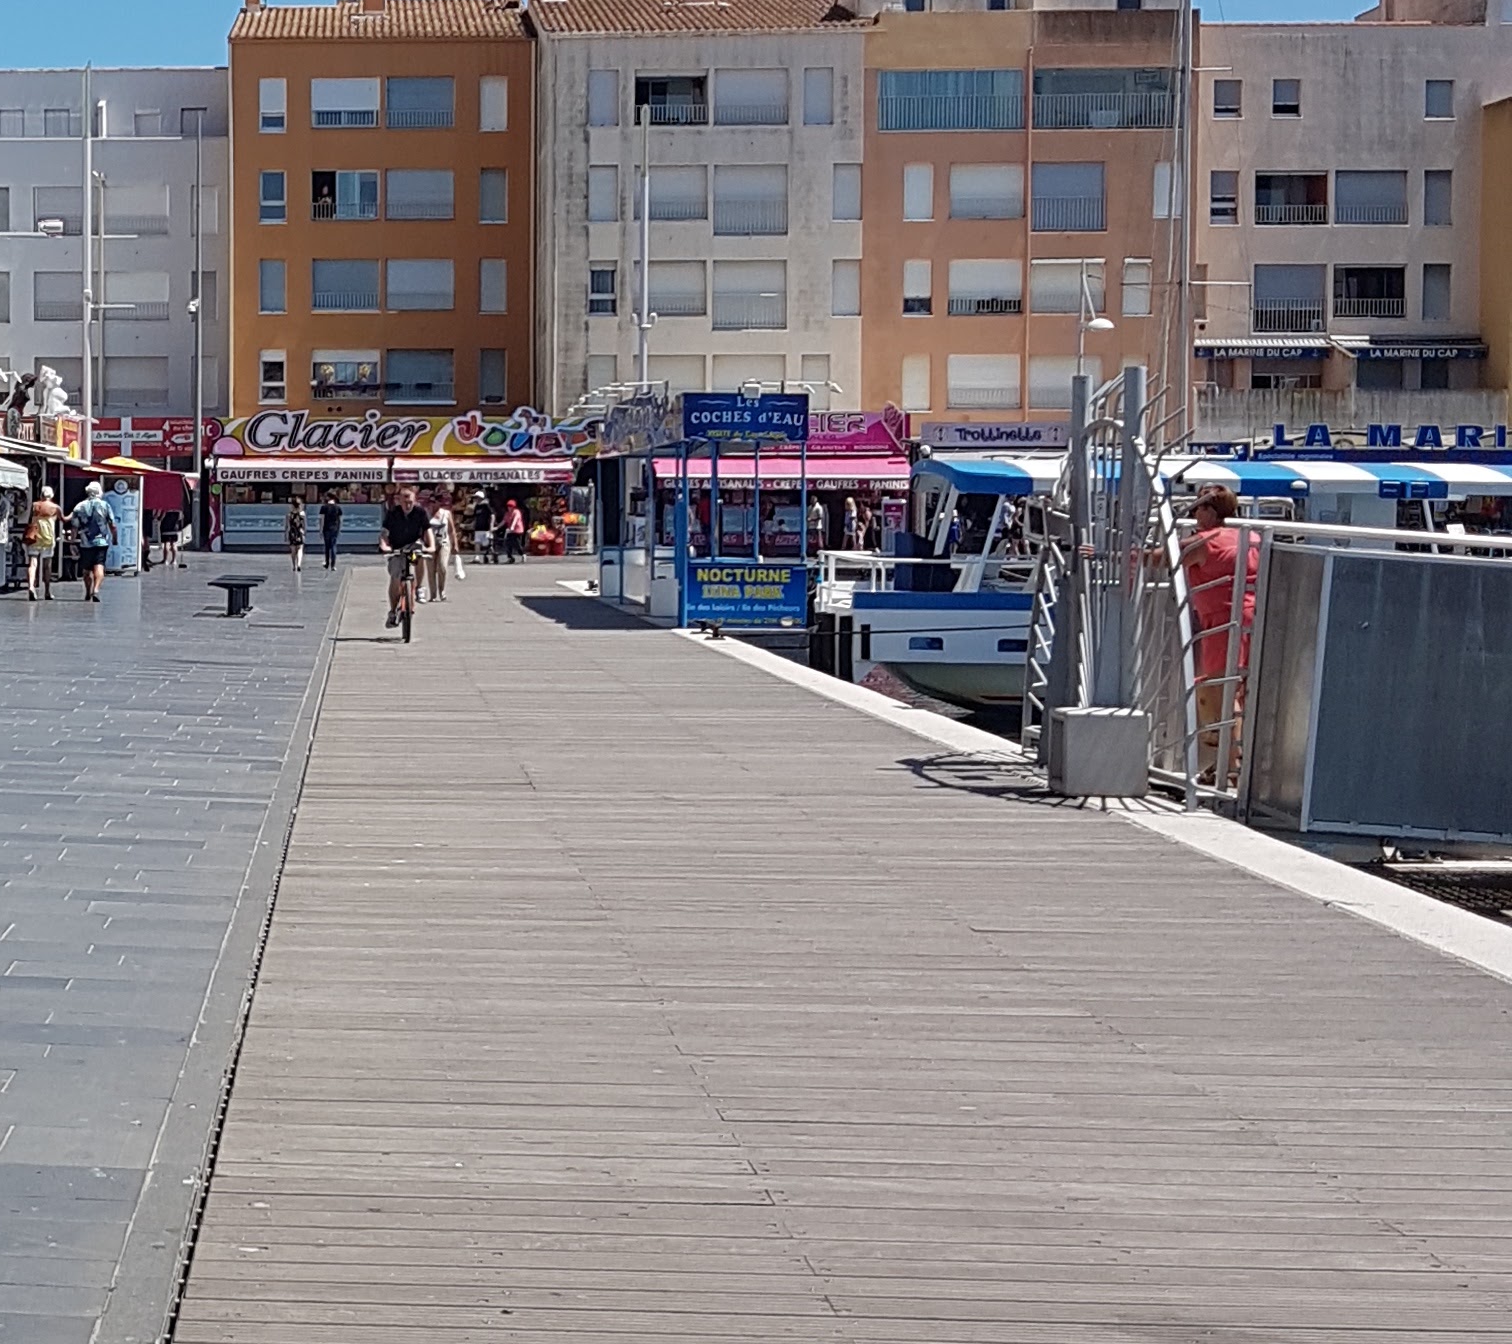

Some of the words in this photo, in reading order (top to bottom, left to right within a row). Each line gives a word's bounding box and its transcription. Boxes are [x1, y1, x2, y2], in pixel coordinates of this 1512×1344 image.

[1228, 348, 1265, 357] MARINE
[1267, 348, 1280, 357] DU
[1281, 348, 1303, 357] CAP
[1369, 348, 1382, 358] LA
[1383, 348, 1420, 358] MARINE
[1422, 349, 1436, 358] DU
[1437, 349, 1458, 358] CAP
[737, 394, 760, 407] Les
[690, 411, 752, 425] COCHES
[757, 412, 805, 427] d'EAU
[247, 410, 428, 449] Glacier
[954, 427, 1043, 442] Trottinette
[1271, 422, 1333, 448] LA
[220, 470, 277, 481] GAUFRES
[281, 469, 330, 481] CREPES
[333, 470, 384, 481] PANINIS
[421, 470, 463, 481] GLACES
[468, 470, 541, 481] ARTISANALES
[816, 479, 859, 490] GAUFRES
[869, 479, 909, 491] PANINIS
[696, 568, 792, 584] NOCTURNE
[743, 584, 785, 600] PARK
